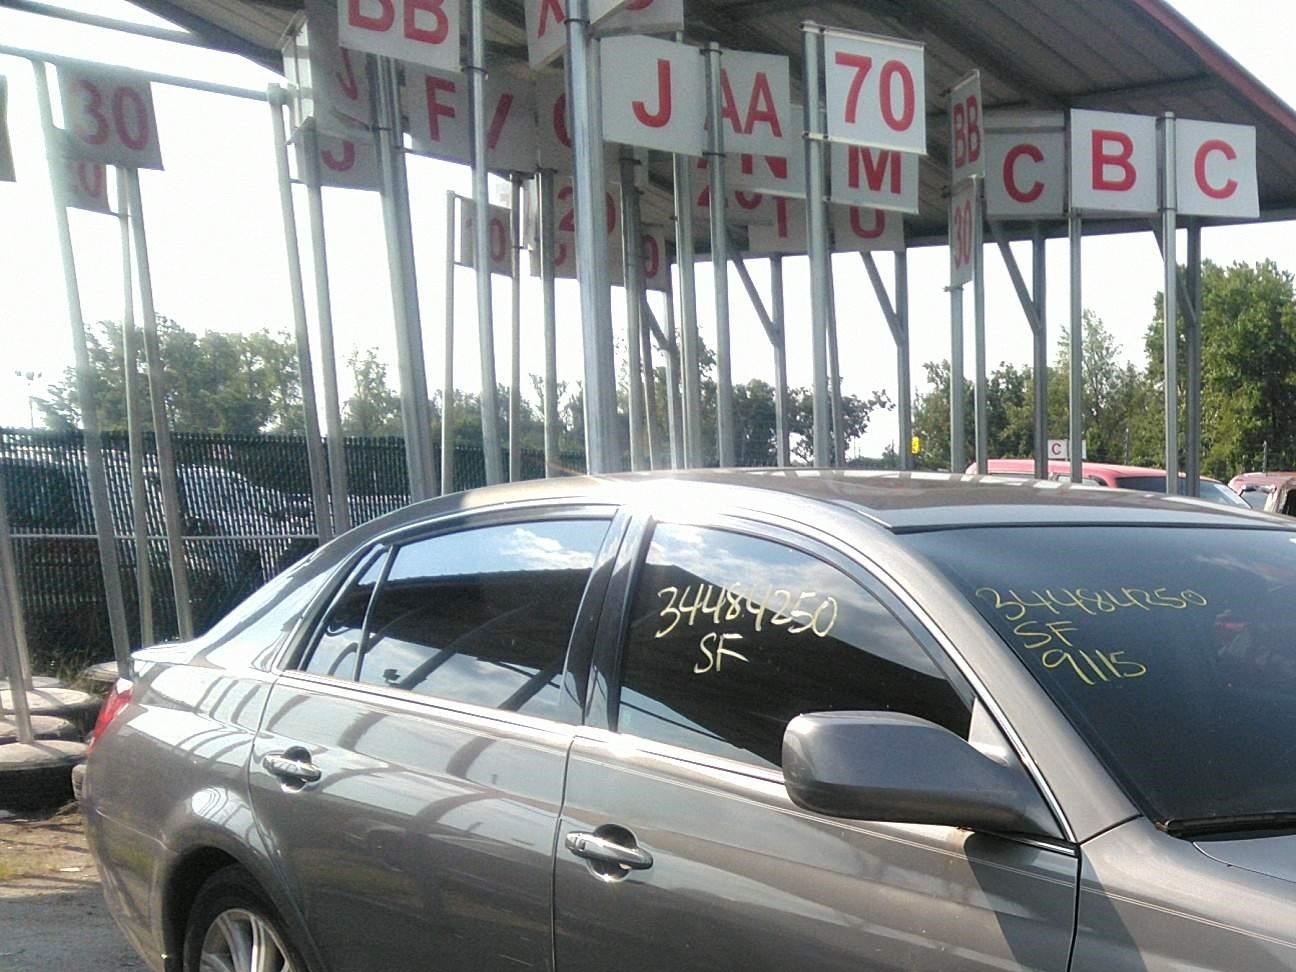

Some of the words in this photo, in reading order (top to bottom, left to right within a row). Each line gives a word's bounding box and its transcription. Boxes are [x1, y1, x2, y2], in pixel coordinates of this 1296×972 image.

[69, 79, 149, 151] 30
[425, 75, 456, 142] F
[632, 59, 672, 128] J
[704, 68, 783, 138] AA
[835, 52, 915, 132] 70
[954, 95, 980, 168] BB
[1091, 129, 1137, 191] B
[848, 145, 901, 194] M
[1003, 143, 1045, 203] C
[1194, 139, 1238, 199] C
[954, 199, 972, 270] 30
[1051, 442, 1062, 456] C
[655, 582, 839, 639] 34484250
[976, 586, 1208, 621] 34484250
[694, 632, 751, 674] SF
[1013, 620, 1079, 650] SF
[1041, 649, 1148, 686] 9115
